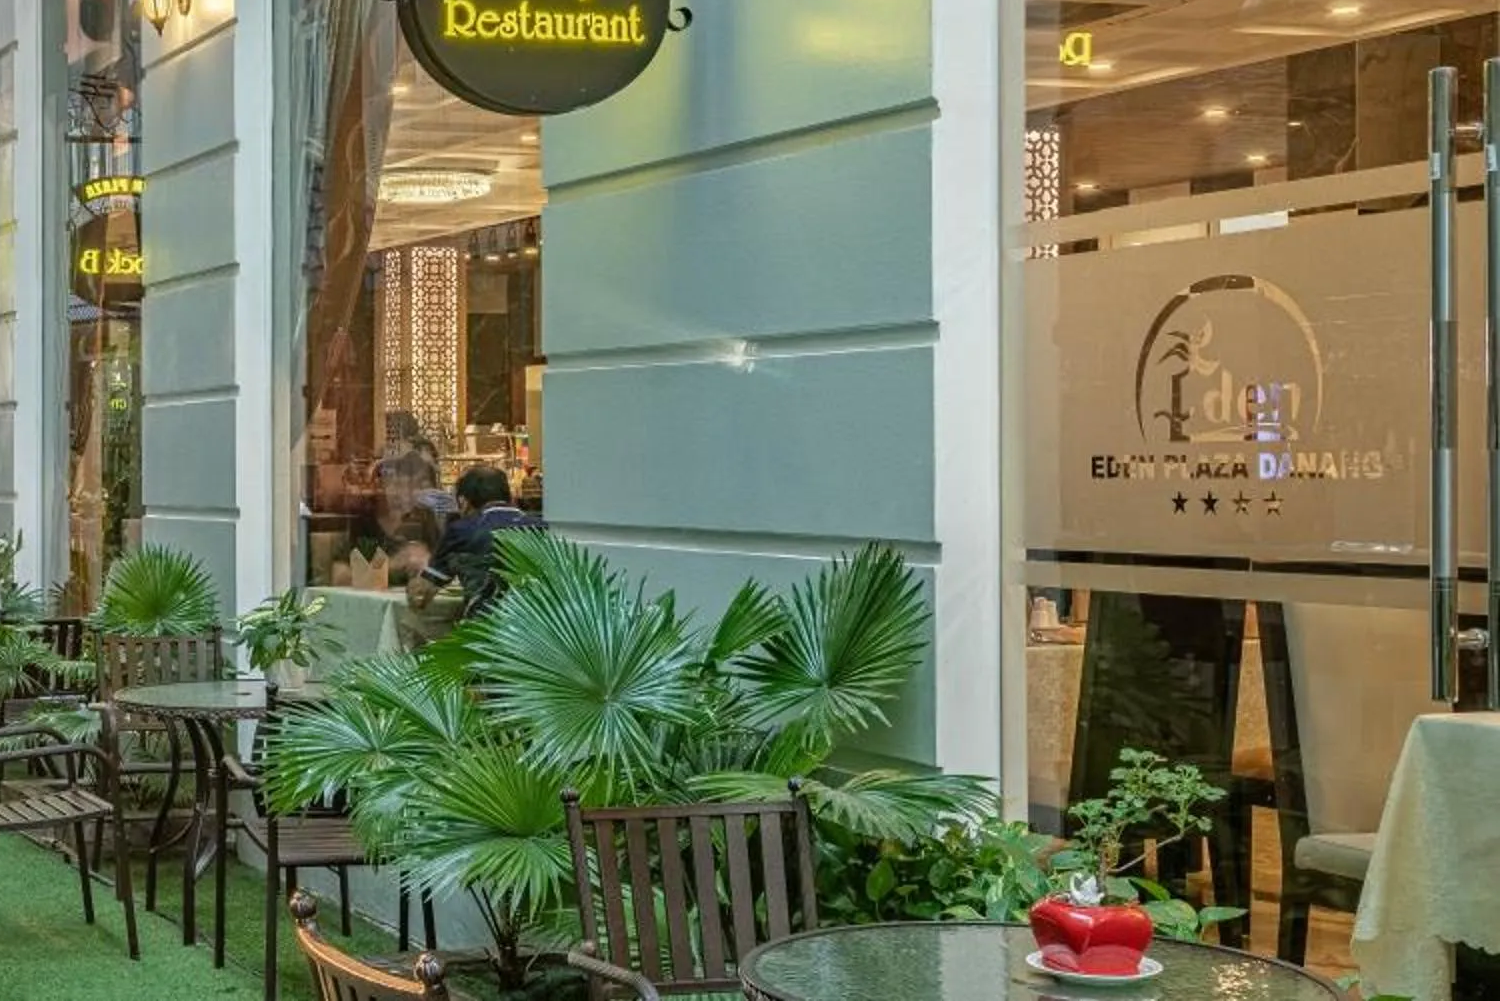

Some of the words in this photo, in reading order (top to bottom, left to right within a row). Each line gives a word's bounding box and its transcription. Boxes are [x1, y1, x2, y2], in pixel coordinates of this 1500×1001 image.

[1091, 455, 1155, 479] EDEN
[1163, 454, 1250, 480] PLAZA
[1258, 451, 1384, 480] DANANG
